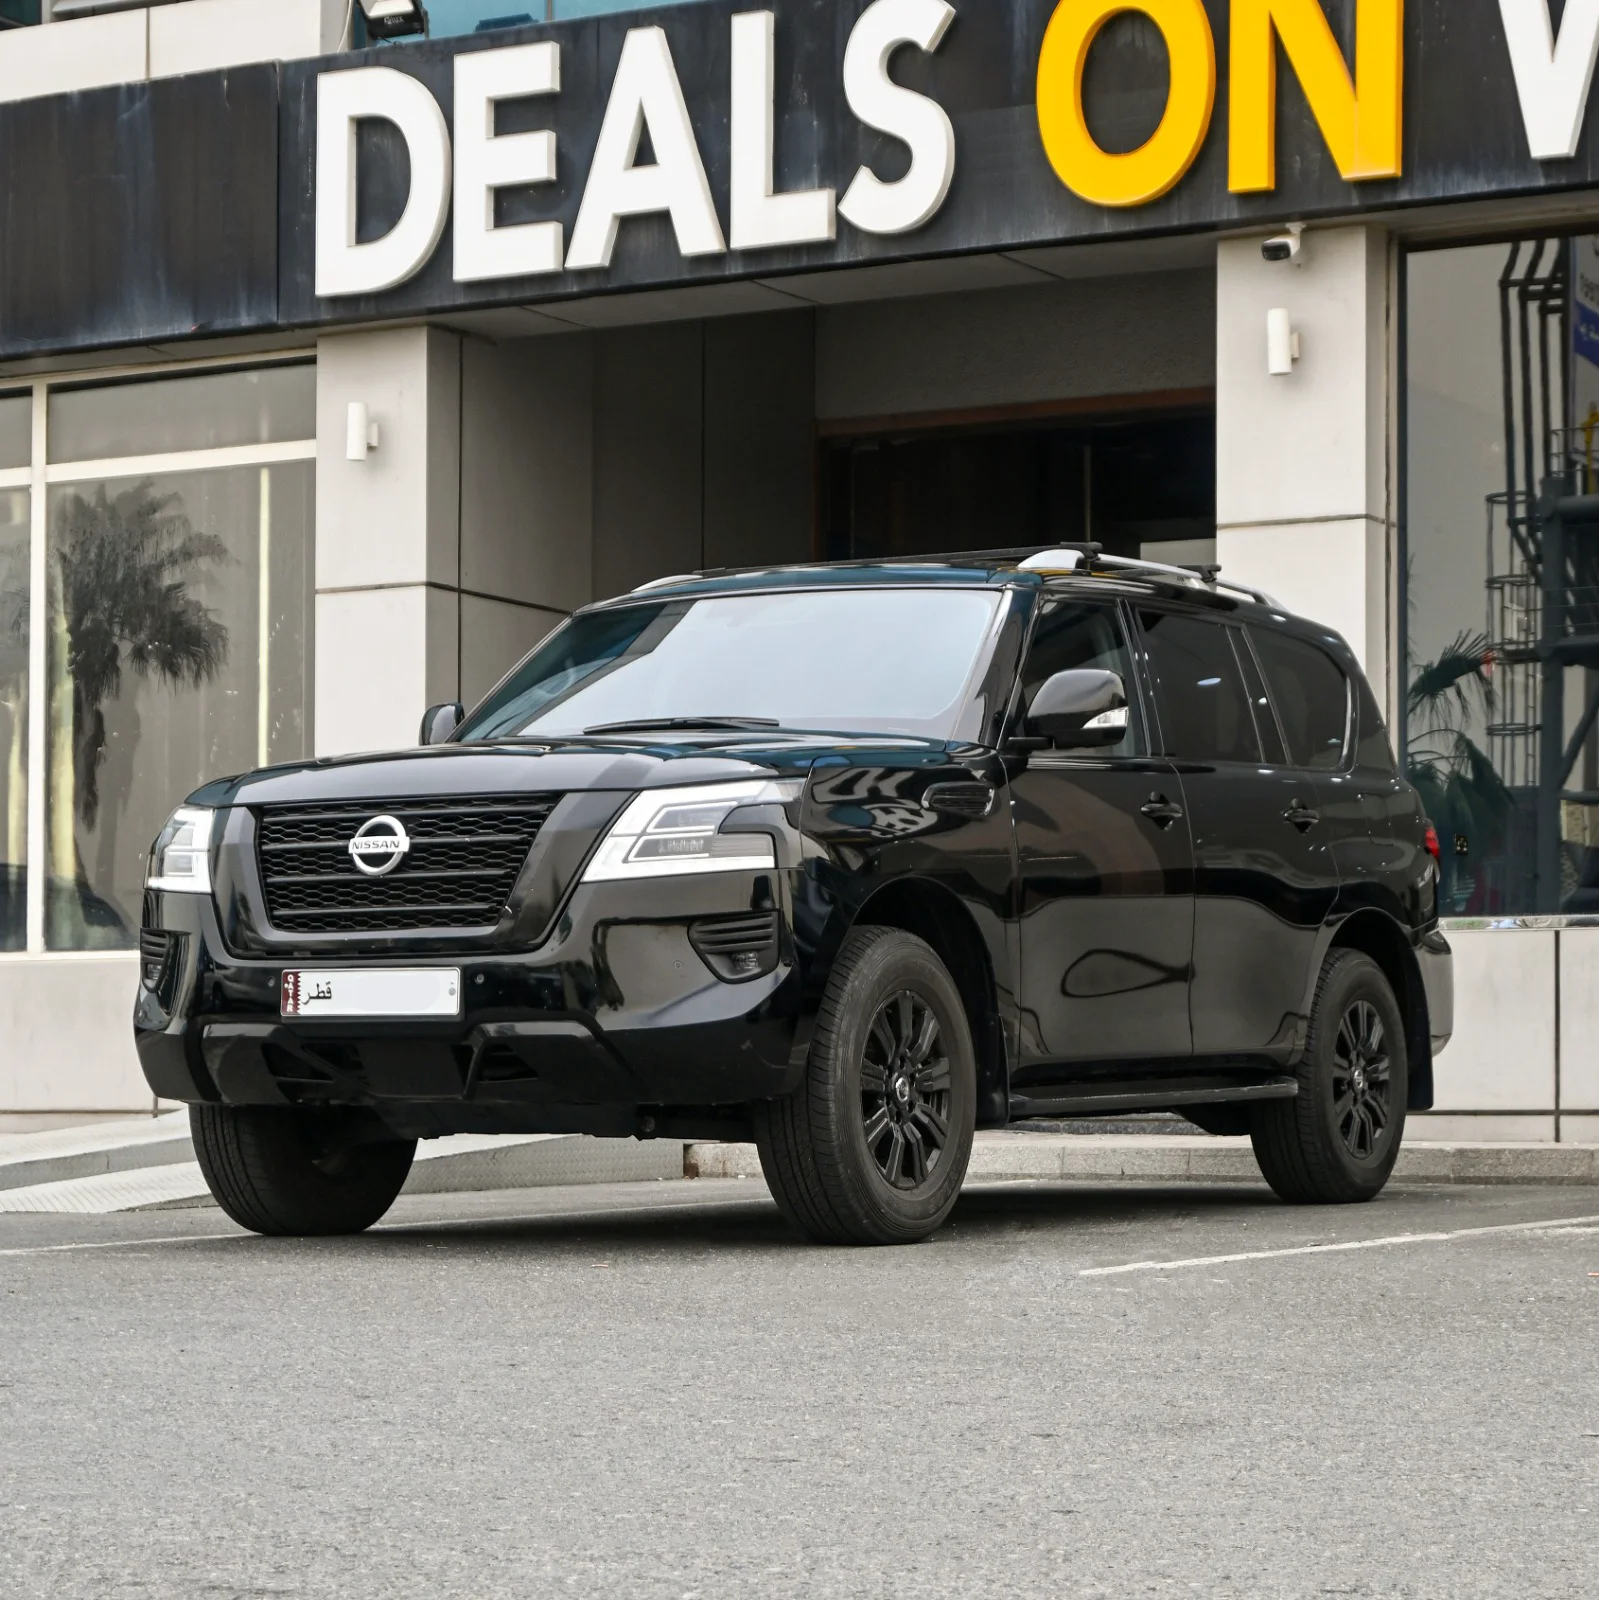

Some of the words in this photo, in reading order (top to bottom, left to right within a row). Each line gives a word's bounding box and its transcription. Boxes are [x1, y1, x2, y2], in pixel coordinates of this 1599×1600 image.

[315, 0, 956, 298] DEALS
[1036, 0, 1404, 207] ON
[352, 840, 400, 850] NISSAN
[301, 981, 332, 1005] قطر
